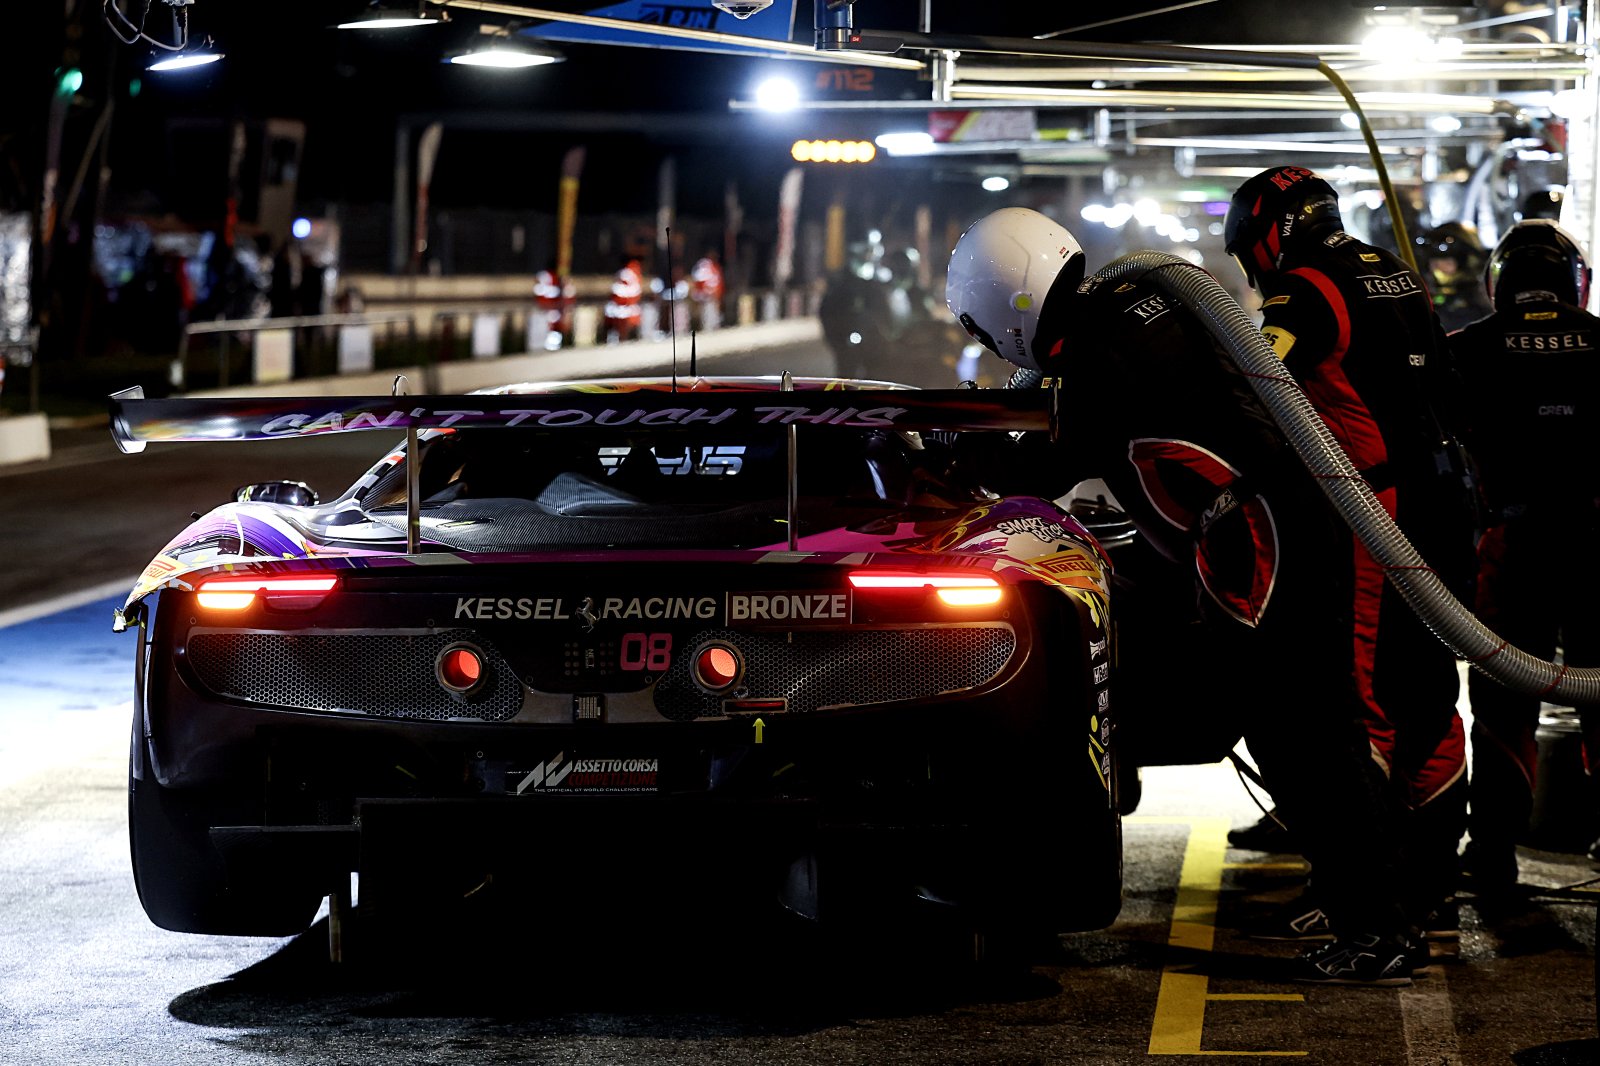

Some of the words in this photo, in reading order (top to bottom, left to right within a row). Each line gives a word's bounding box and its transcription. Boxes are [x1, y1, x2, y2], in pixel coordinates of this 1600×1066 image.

[1282, 213, 1294, 237] VALE
[1364, 276, 1416, 293] KESSEL
[1504, 334, 1588, 350] KESSEL
[1538, 405, 1575, 416] CREW
[260, 406, 485, 436] CAN'T
[497, 406, 738, 427] TOUCH
[752, 405, 910, 427] THIS
[997, 516, 1043, 536] SMART
[454, 597, 570, 620] KESSEL
[602, 597, 717, 620] RACING
[732, 594, 848, 620] BRONZE
[620, 632, 673, 671] 08
[573, 759, 621, 773] ASSETTO
[622, 758, 659, 772] CORSA
[567, 772, 658, 787] COMPETIZIONE
